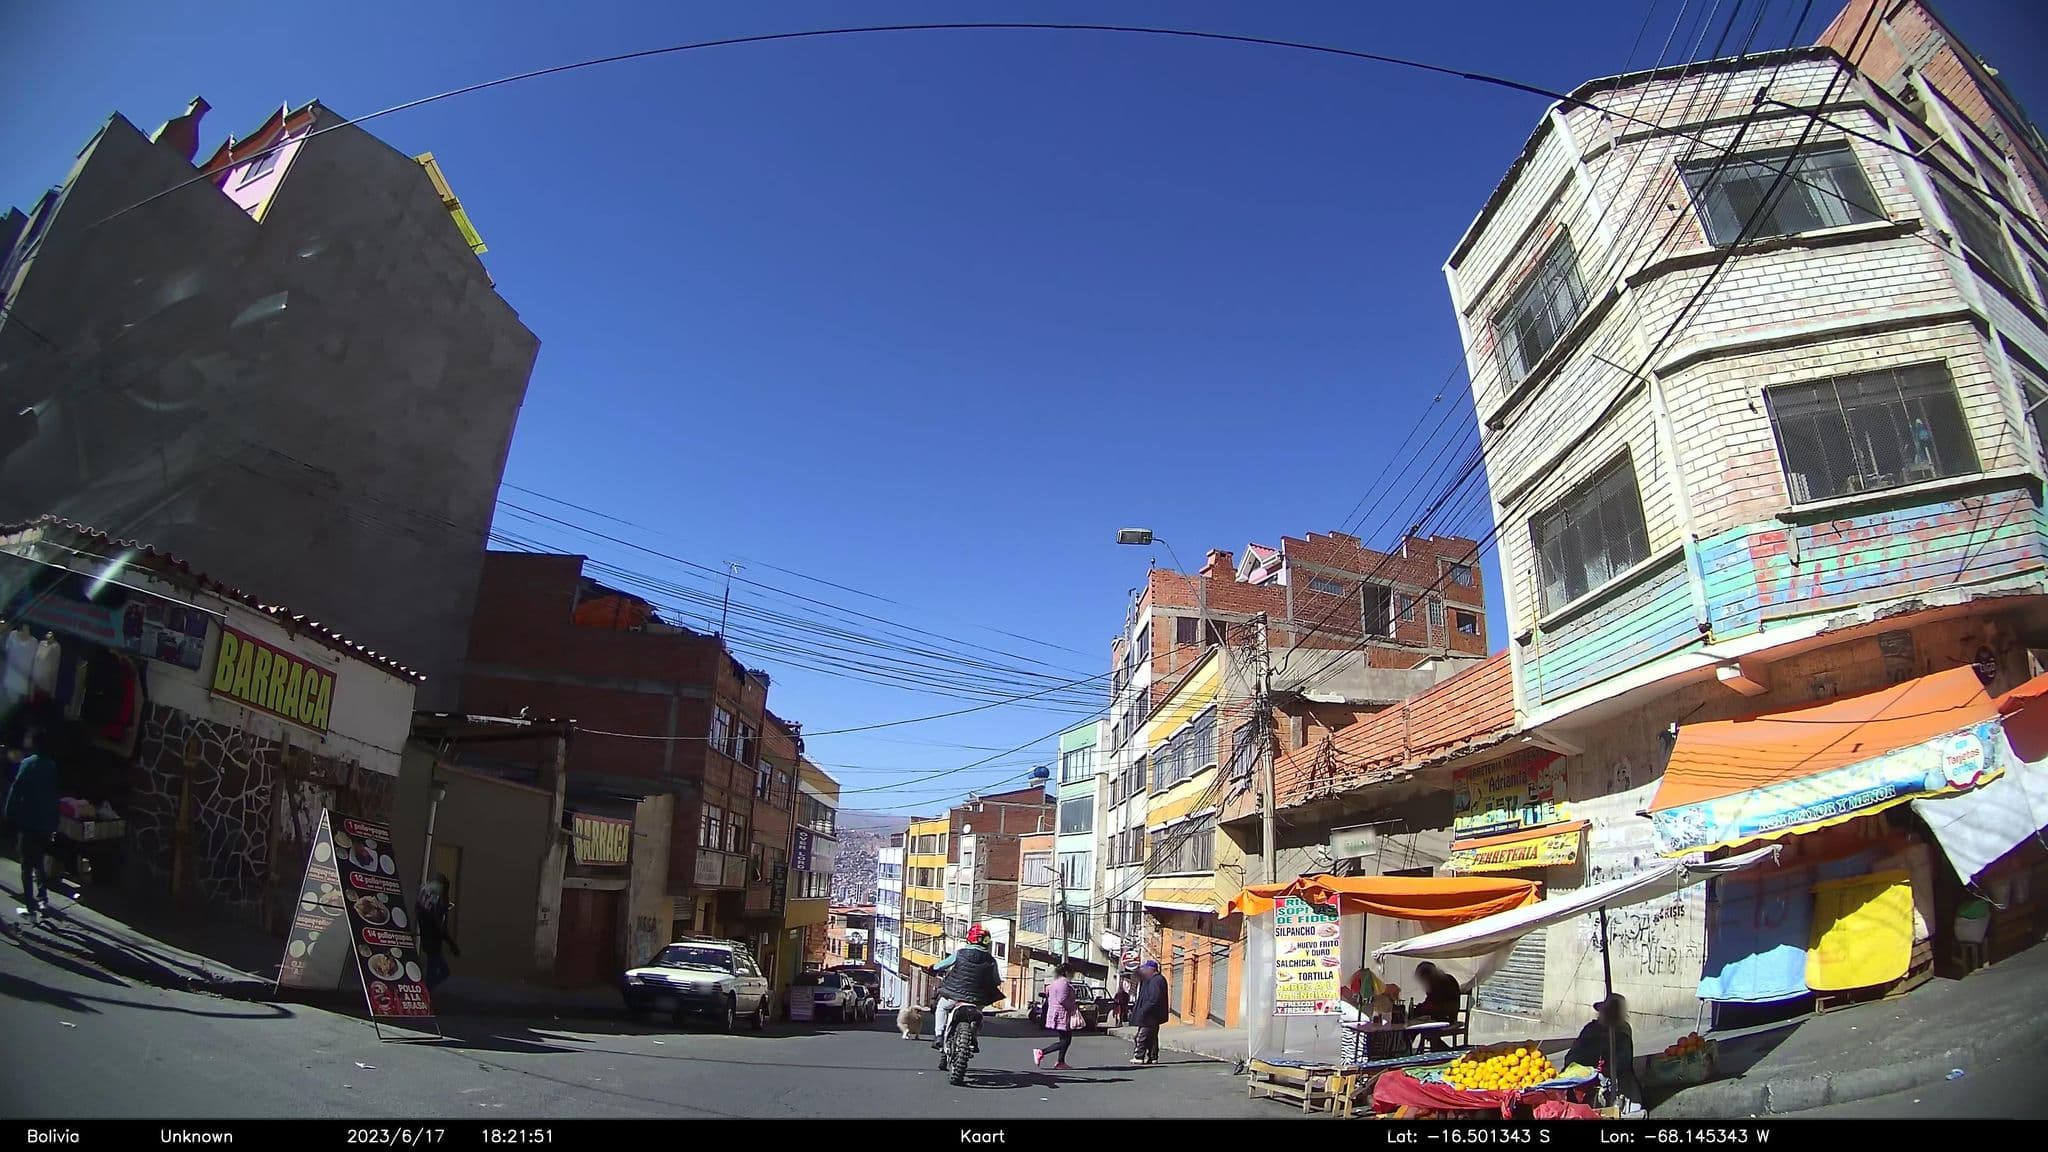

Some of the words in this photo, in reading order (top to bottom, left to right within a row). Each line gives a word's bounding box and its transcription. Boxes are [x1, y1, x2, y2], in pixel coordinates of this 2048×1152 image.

[213, 630, 332, 730] BARRACA
[1787, 801, 1836, 825] MAYOR
[1836, 799, 1849, 813] Y
[1848, 785, 1897, 809] MENOR
[575, 817, 630, 862] BARRACA
[1277, 905, 1336, 916] SOPIAS
[1276, 916, 1293, 924] DE
[1298, 914, 1338, 923] FIDEO
[1275, 926, 1316, 937] SILPANCHO
[1297, 941, 1318, 949] HUEVO
[1319, 940, 1339, 948] FRITO
[1305, 949, 1310, 957] Y
[1311, 948, 1331, 957] DURO
[1276, 959, 1316, 968] SALCHICHA
[1298, 971, 1334, 980] TORTILLA
[398, 984, 422, 994] POLLO
[402, 1001, 428, 1011] BRASA
